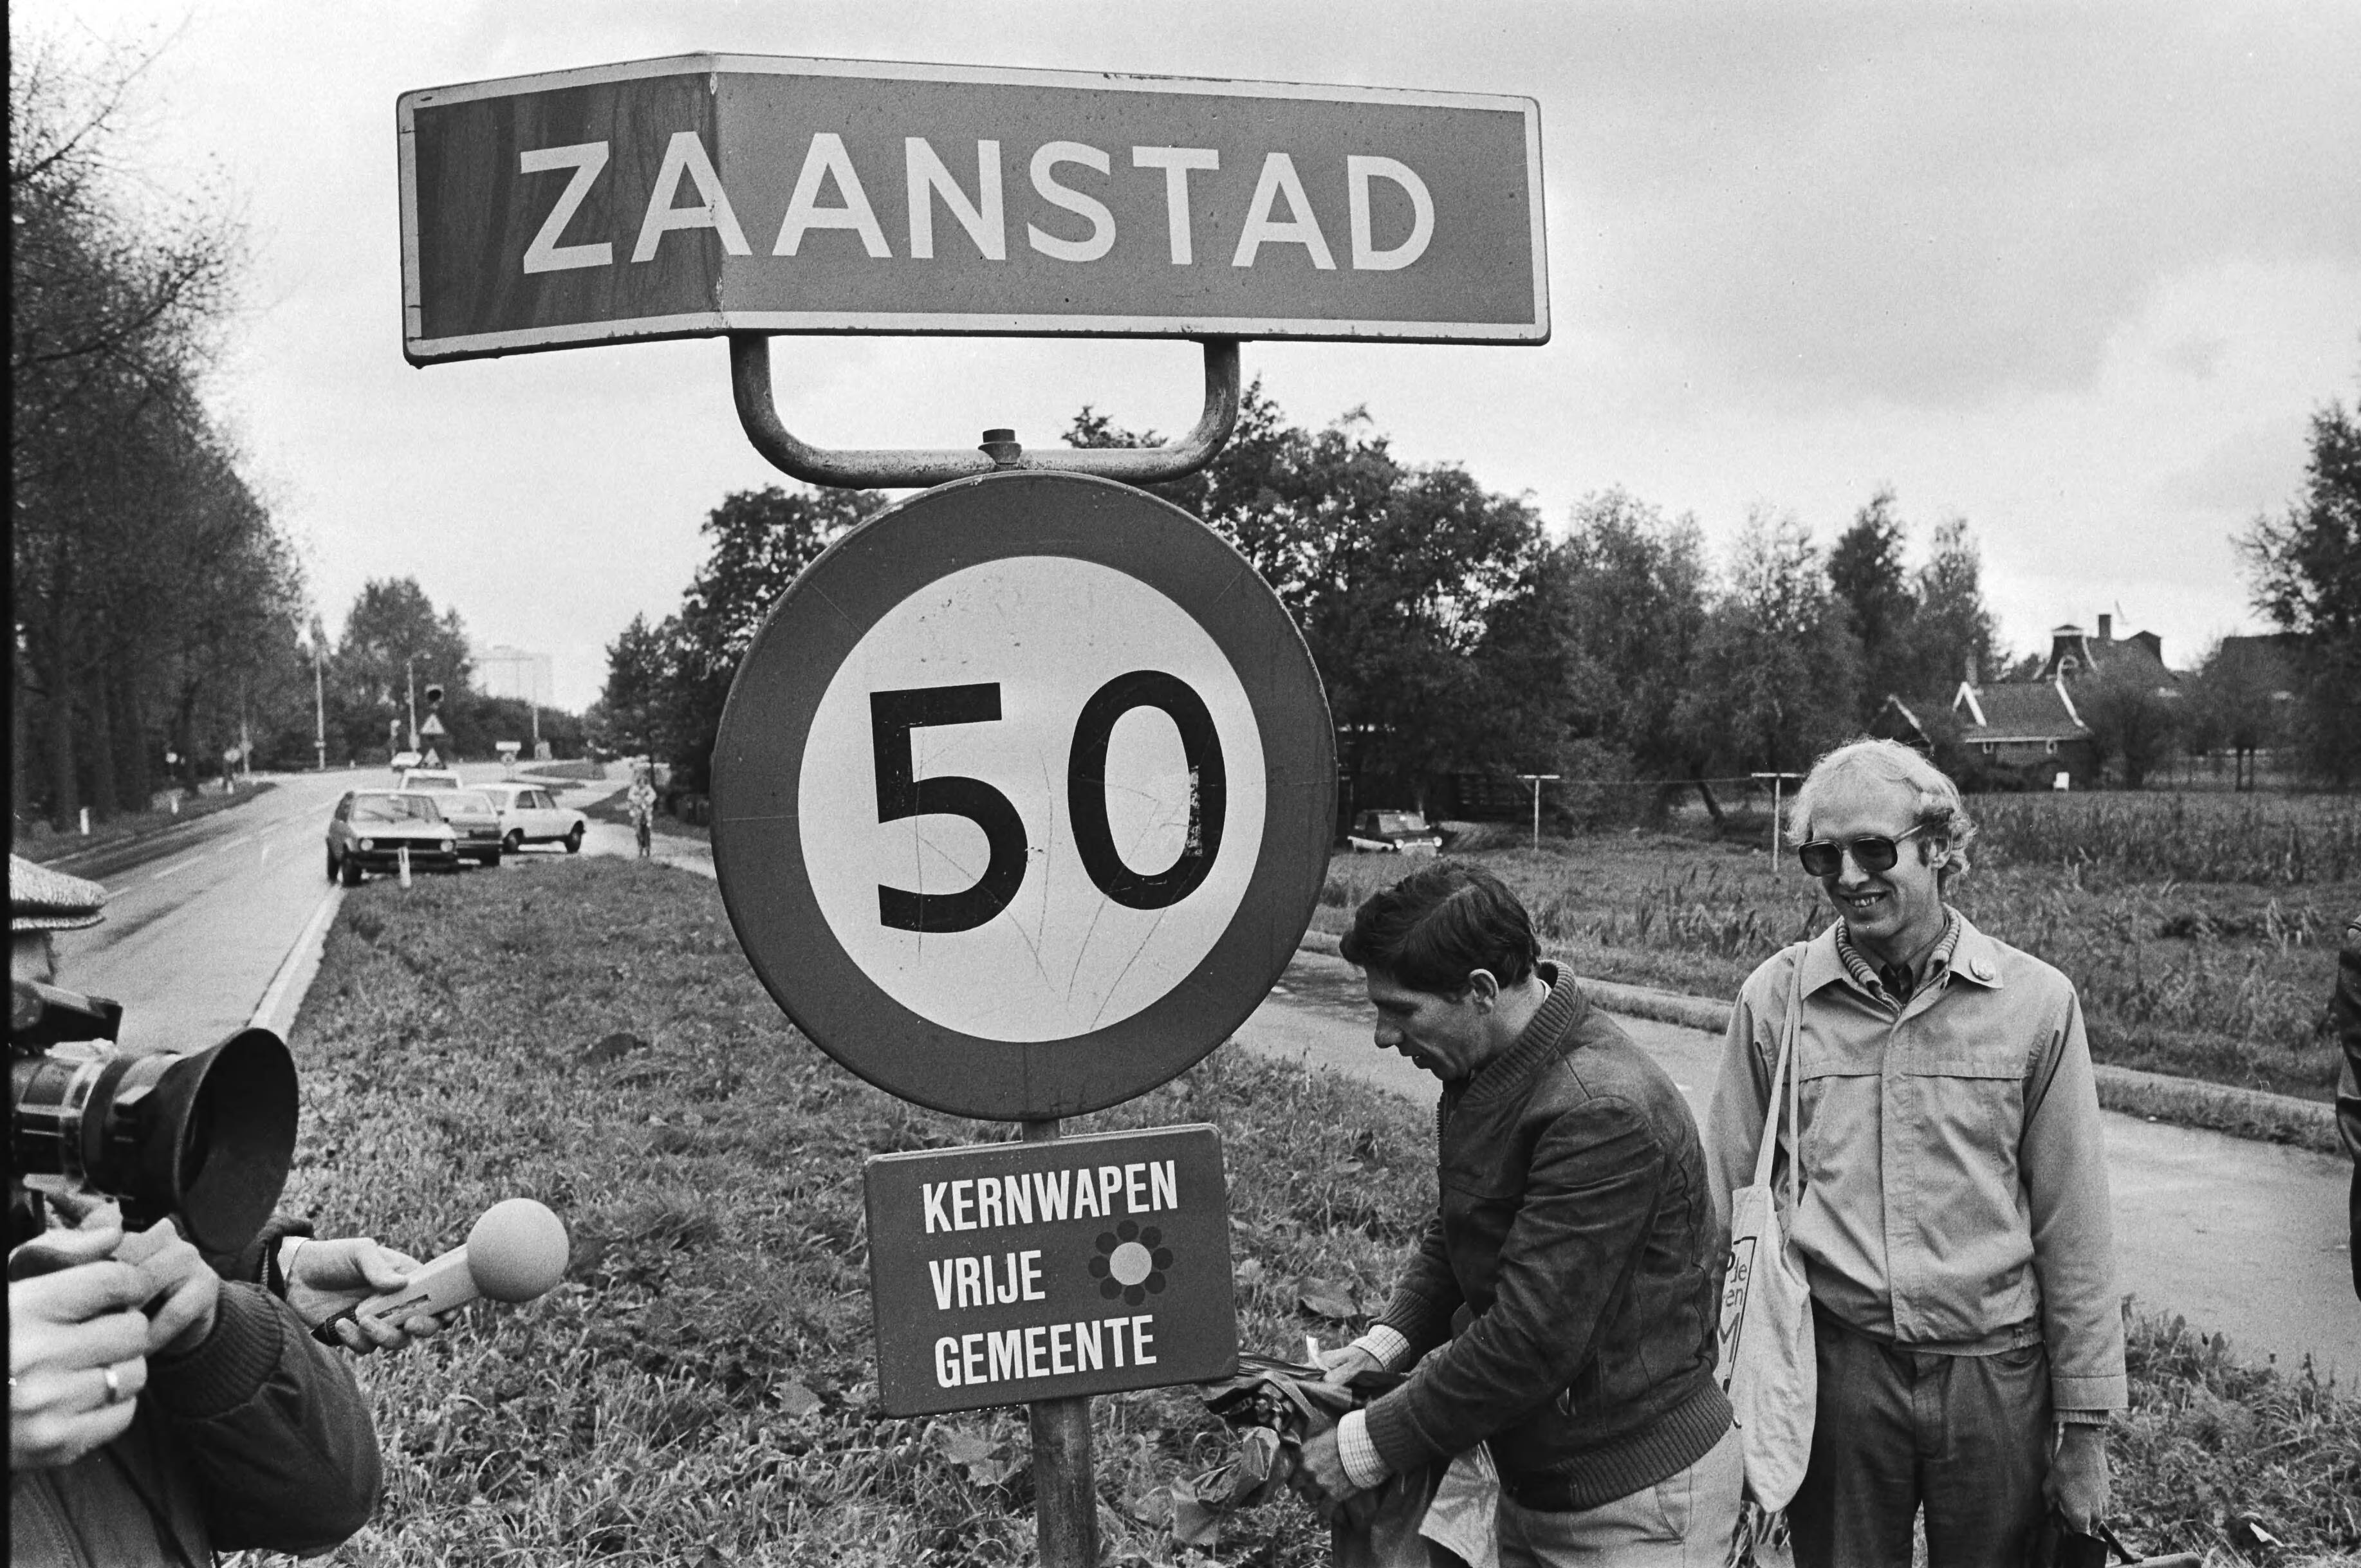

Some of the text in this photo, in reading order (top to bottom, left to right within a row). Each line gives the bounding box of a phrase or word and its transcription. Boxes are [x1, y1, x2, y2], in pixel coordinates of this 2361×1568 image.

[520, 131, 1436, 274] ZAANSTAD
[869, 669, 1227, 934] 50
[922, 1160, 1178, 1234] KERNWAPEN
[929, 1250, 1046, 1310] VRIJE
[1723, 1288, 1744, 1307] en
[934, 1314, 1158, 1388] GEMEENTE
